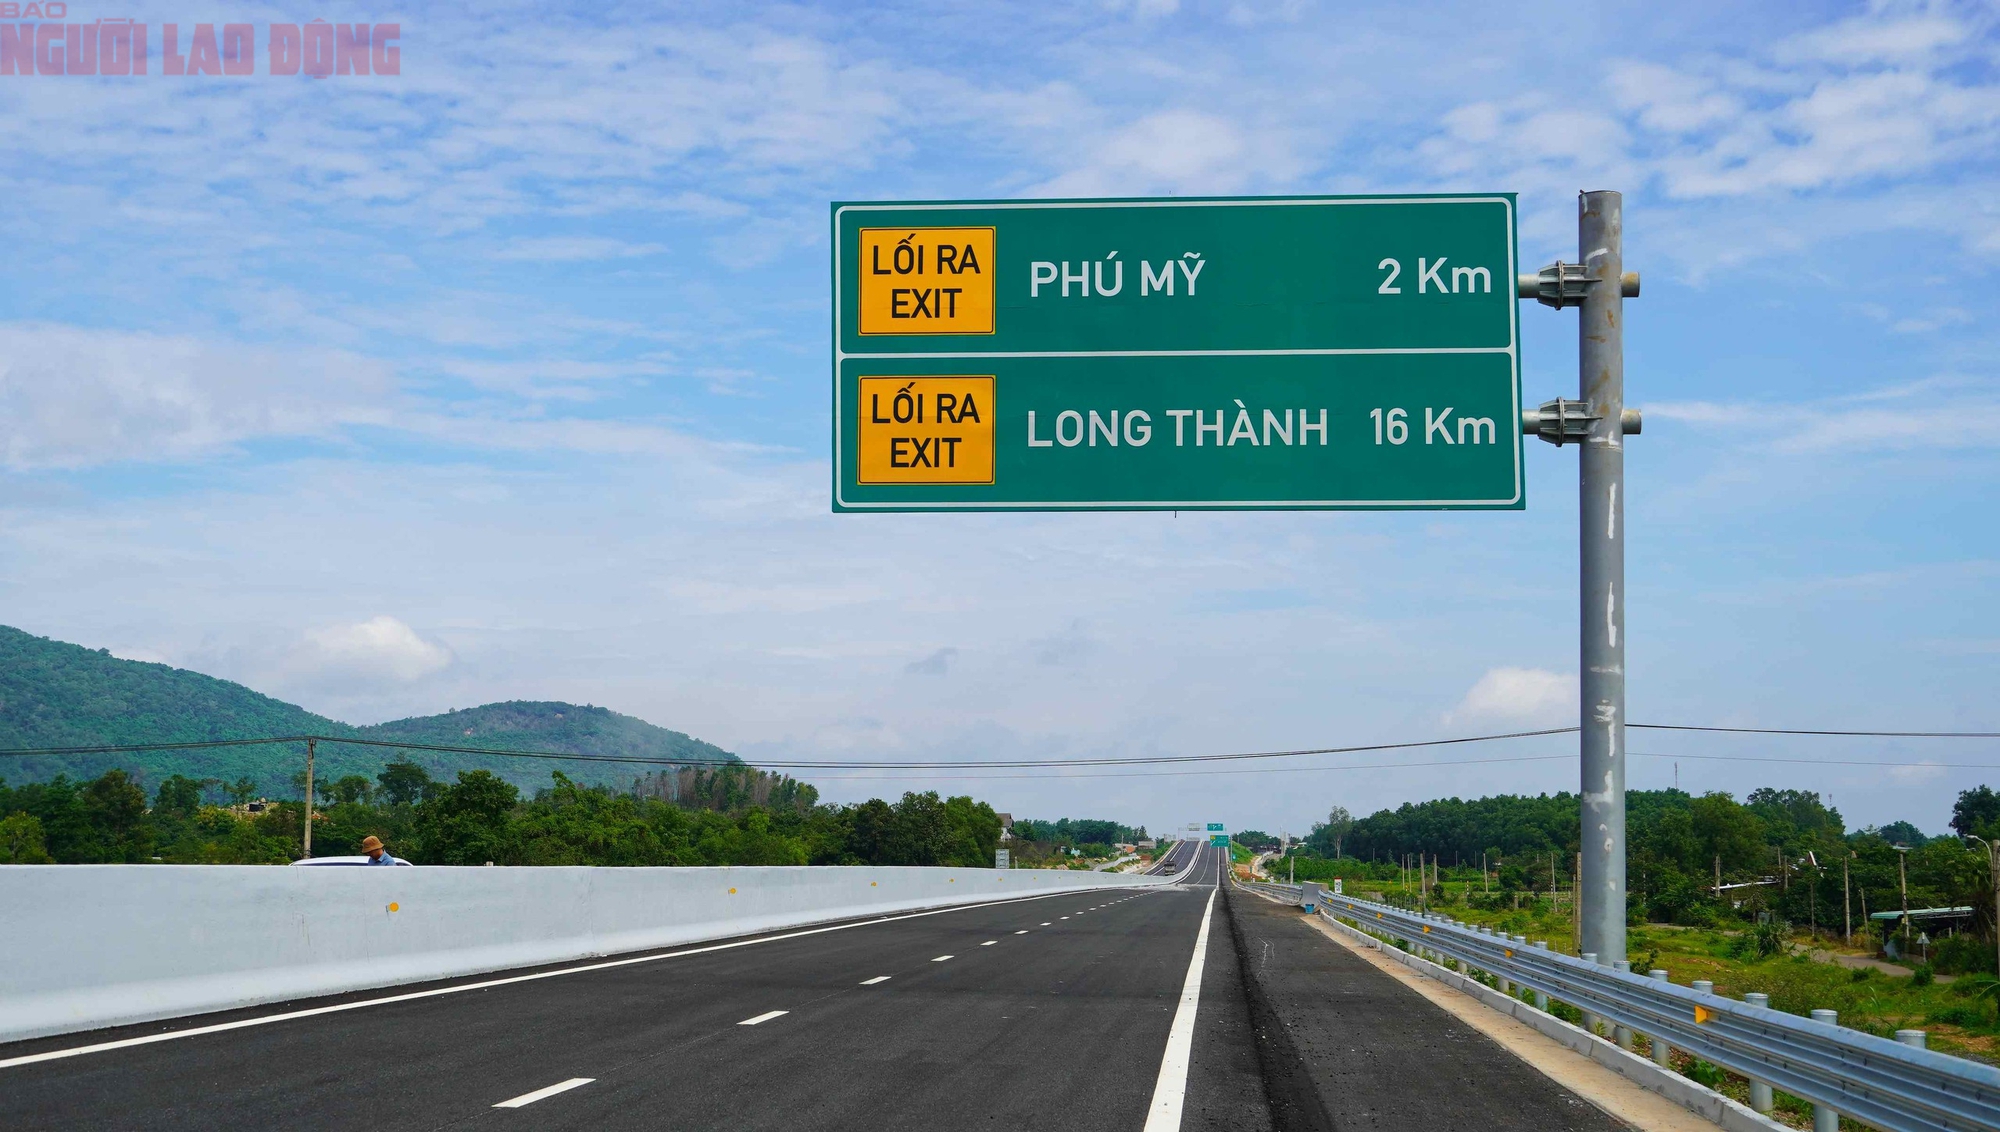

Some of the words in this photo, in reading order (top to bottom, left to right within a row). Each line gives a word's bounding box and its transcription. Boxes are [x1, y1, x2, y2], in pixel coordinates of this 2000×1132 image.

[873, 233, 923, 274] LỐI
[938, 245, 980, 274] RA
[1030, 251, 1122, 297] PHÚ
[1141, 252, 1205, 296] MỸ
[1378, 258, 1400, 294] 2
[1418, 257, 1491, 294] Km
[891, 288, 962, 318] EXIT
[873, 382, 923, 423] LỐI
[937, 394, 980, 423] RA
[1028, 409, 1151, 447] LONG
[1166, 400, 1328, 446] THÀNH
[1370, 408, 1408, 444] 16
[1425, 407, 1496, 444] Km
[891, 437, 962, 467] EXIT
